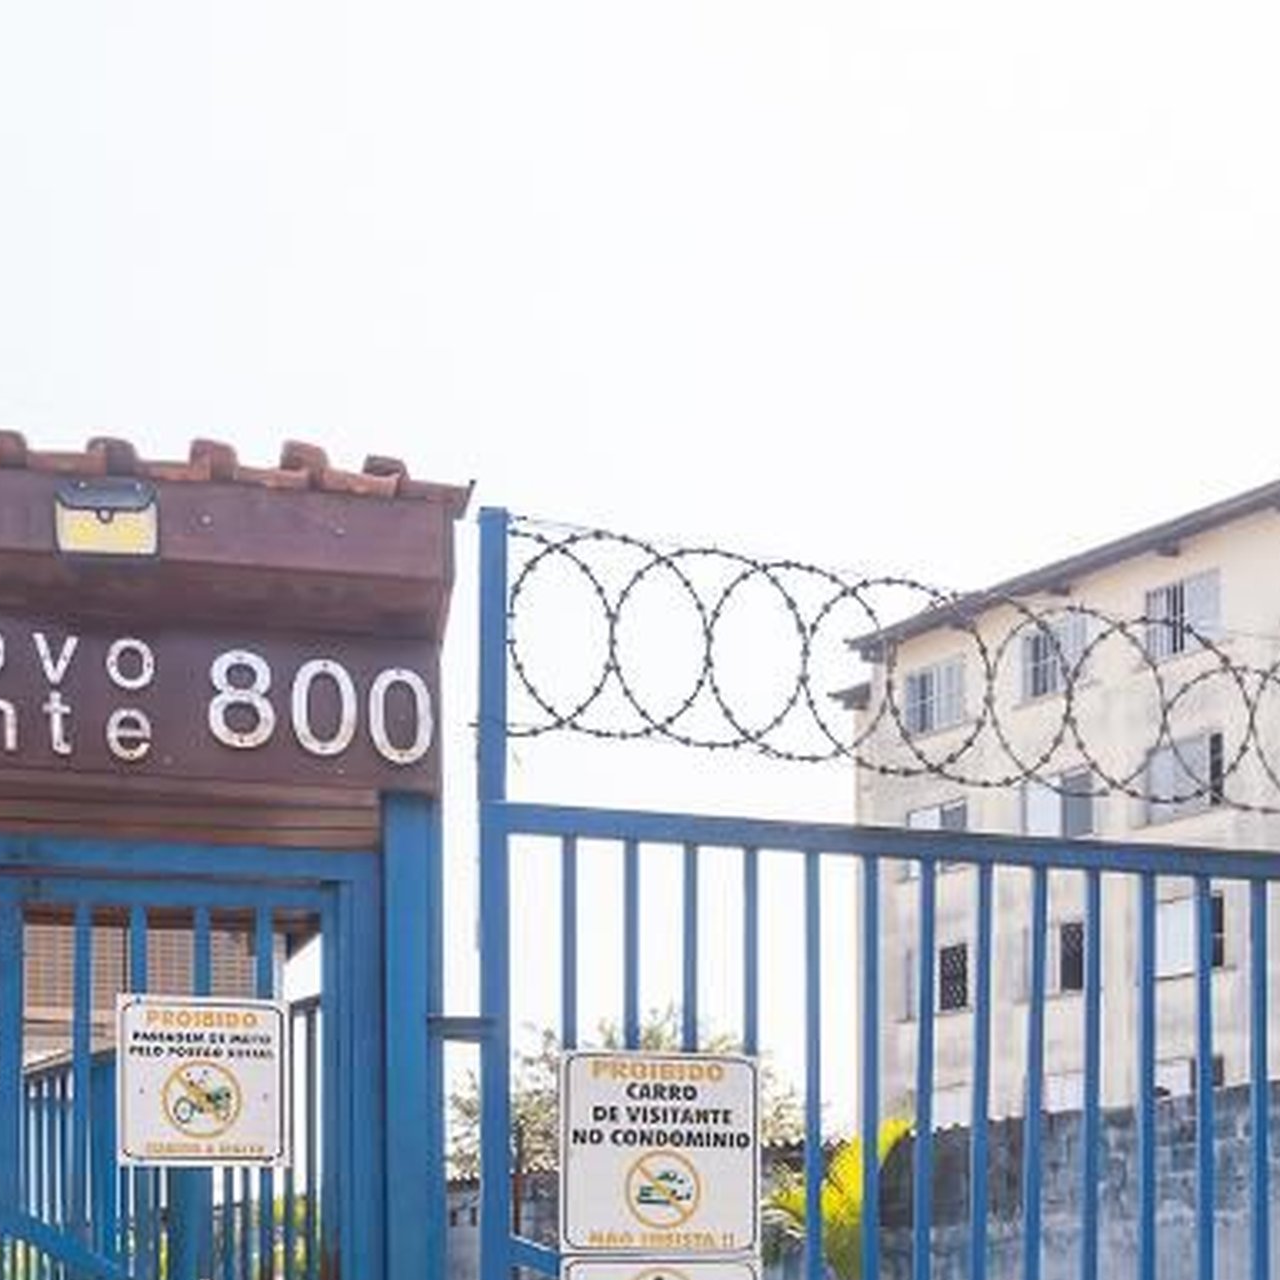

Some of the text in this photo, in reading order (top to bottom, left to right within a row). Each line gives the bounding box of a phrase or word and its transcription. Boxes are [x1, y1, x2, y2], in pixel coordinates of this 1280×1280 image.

[207, 649, 434, 764] 800
[146, 1009, 258, 1028] PROIBIDO
[132, 1031, 205, 1044] PASSAGEM
[208, 1032, 225, 1045] DE
[128, 1045, 164, 1058] PELO
[590, 1060, 726, 1081] PROIBIDO
[625, 1082, 699, 1101] CARRO
[592, 1106, 733, 1125] DE VISITANTE
[572, 1129, 604, 1145] NO
